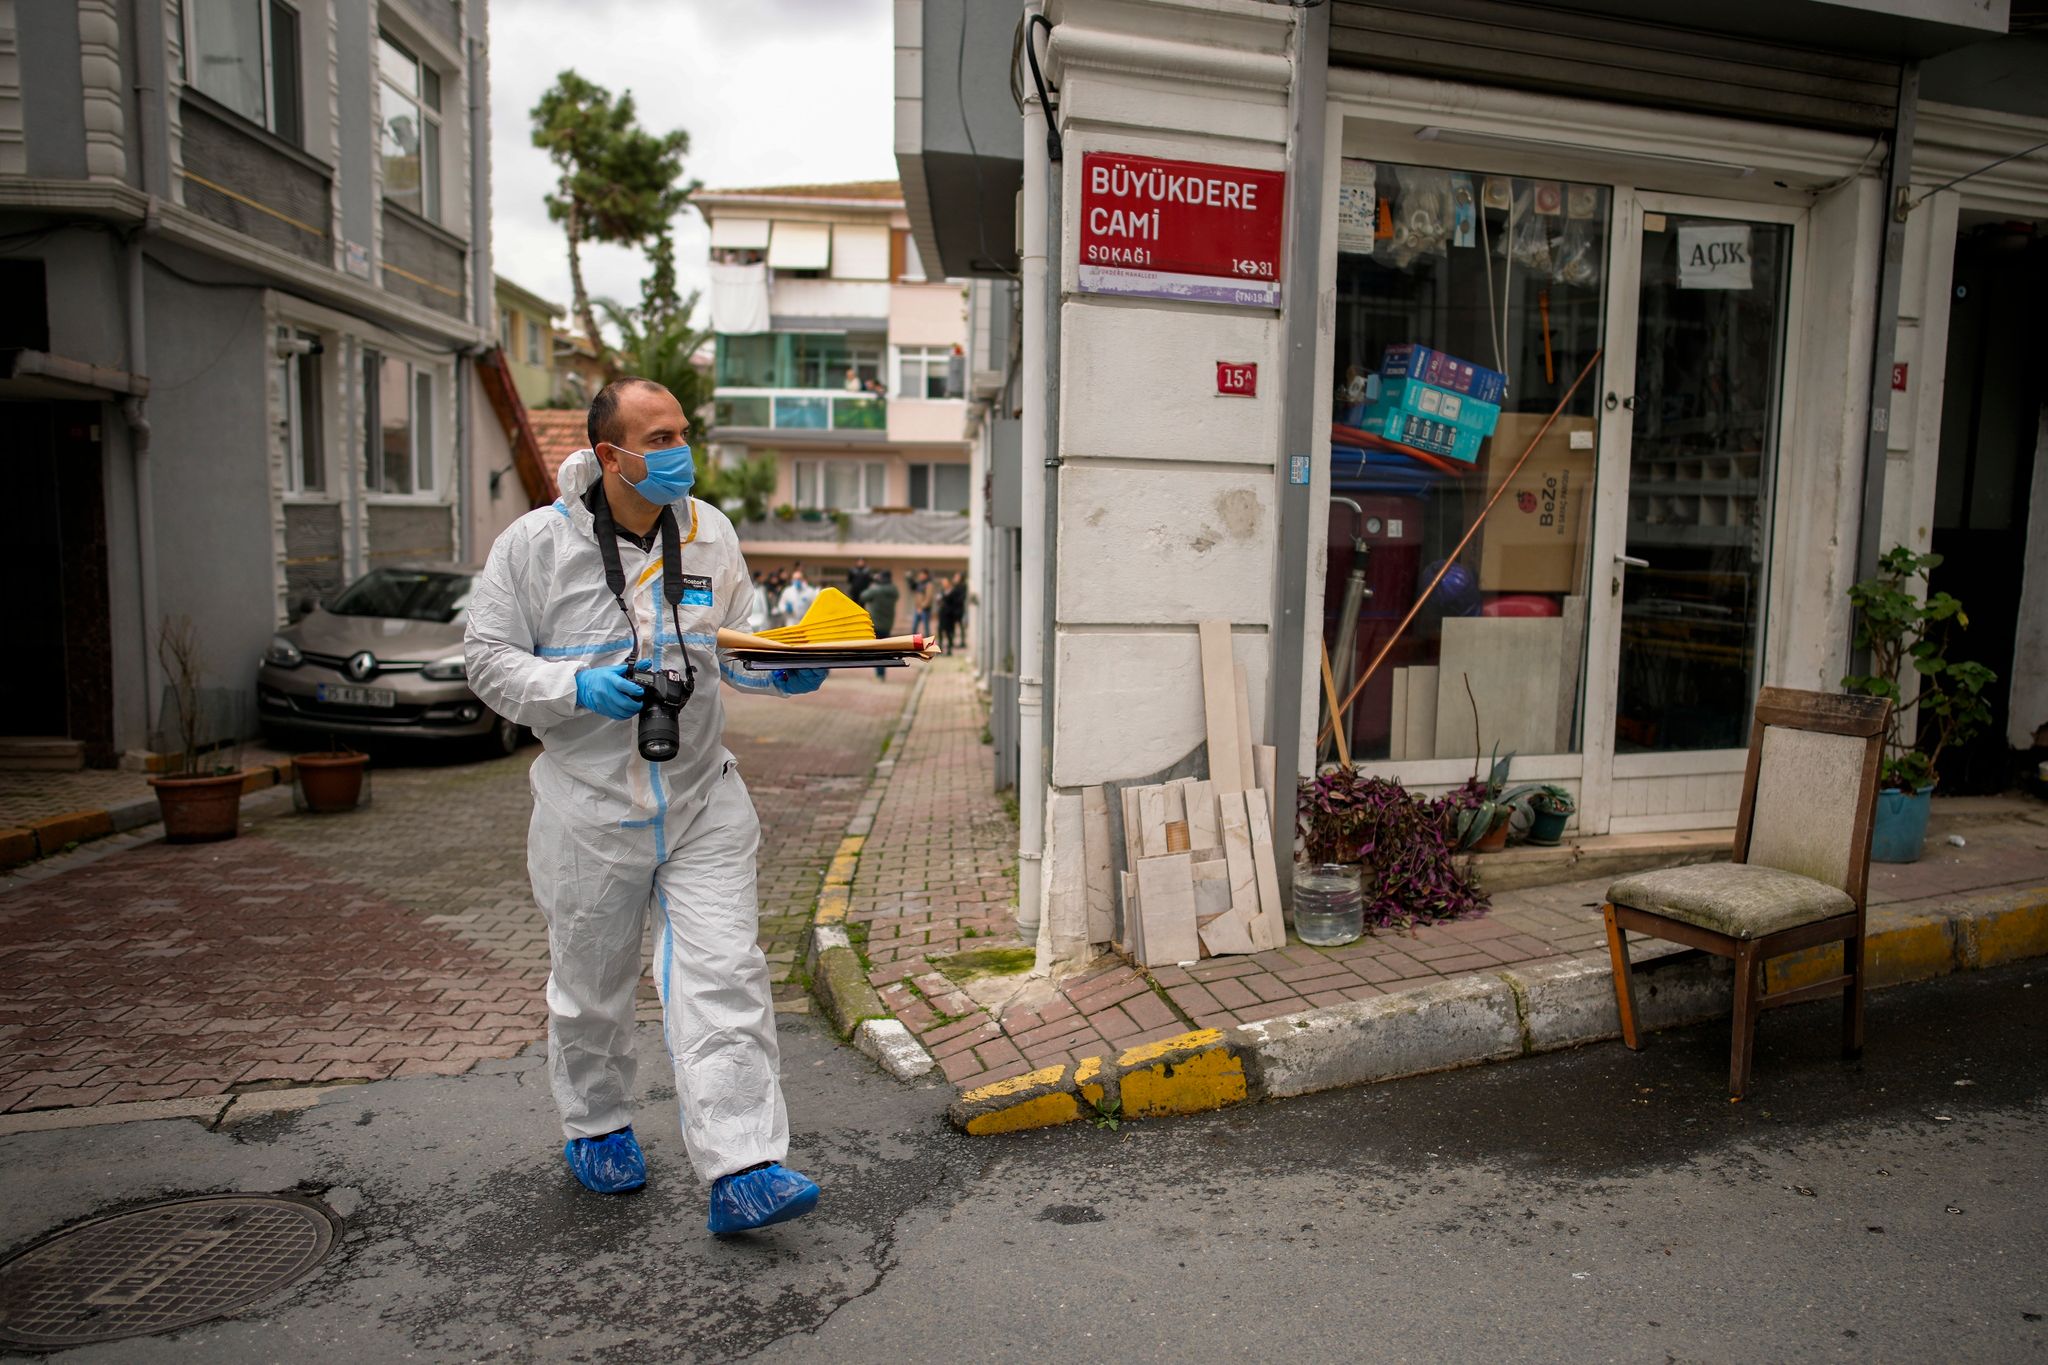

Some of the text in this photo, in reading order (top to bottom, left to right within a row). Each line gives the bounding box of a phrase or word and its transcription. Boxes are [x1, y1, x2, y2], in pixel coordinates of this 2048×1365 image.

[1091, 164, 1258, 211] BÜYÜKDERE
[1089, 207, 1160, 240] CAMİ
[1088, 245, 1151, 265] SOKAĞI
[1232, 258, 1274, 276] 1 31
[1690, 242, 1745, 272] AÇIK
[1540, 477, 1557, 526] BeZe
